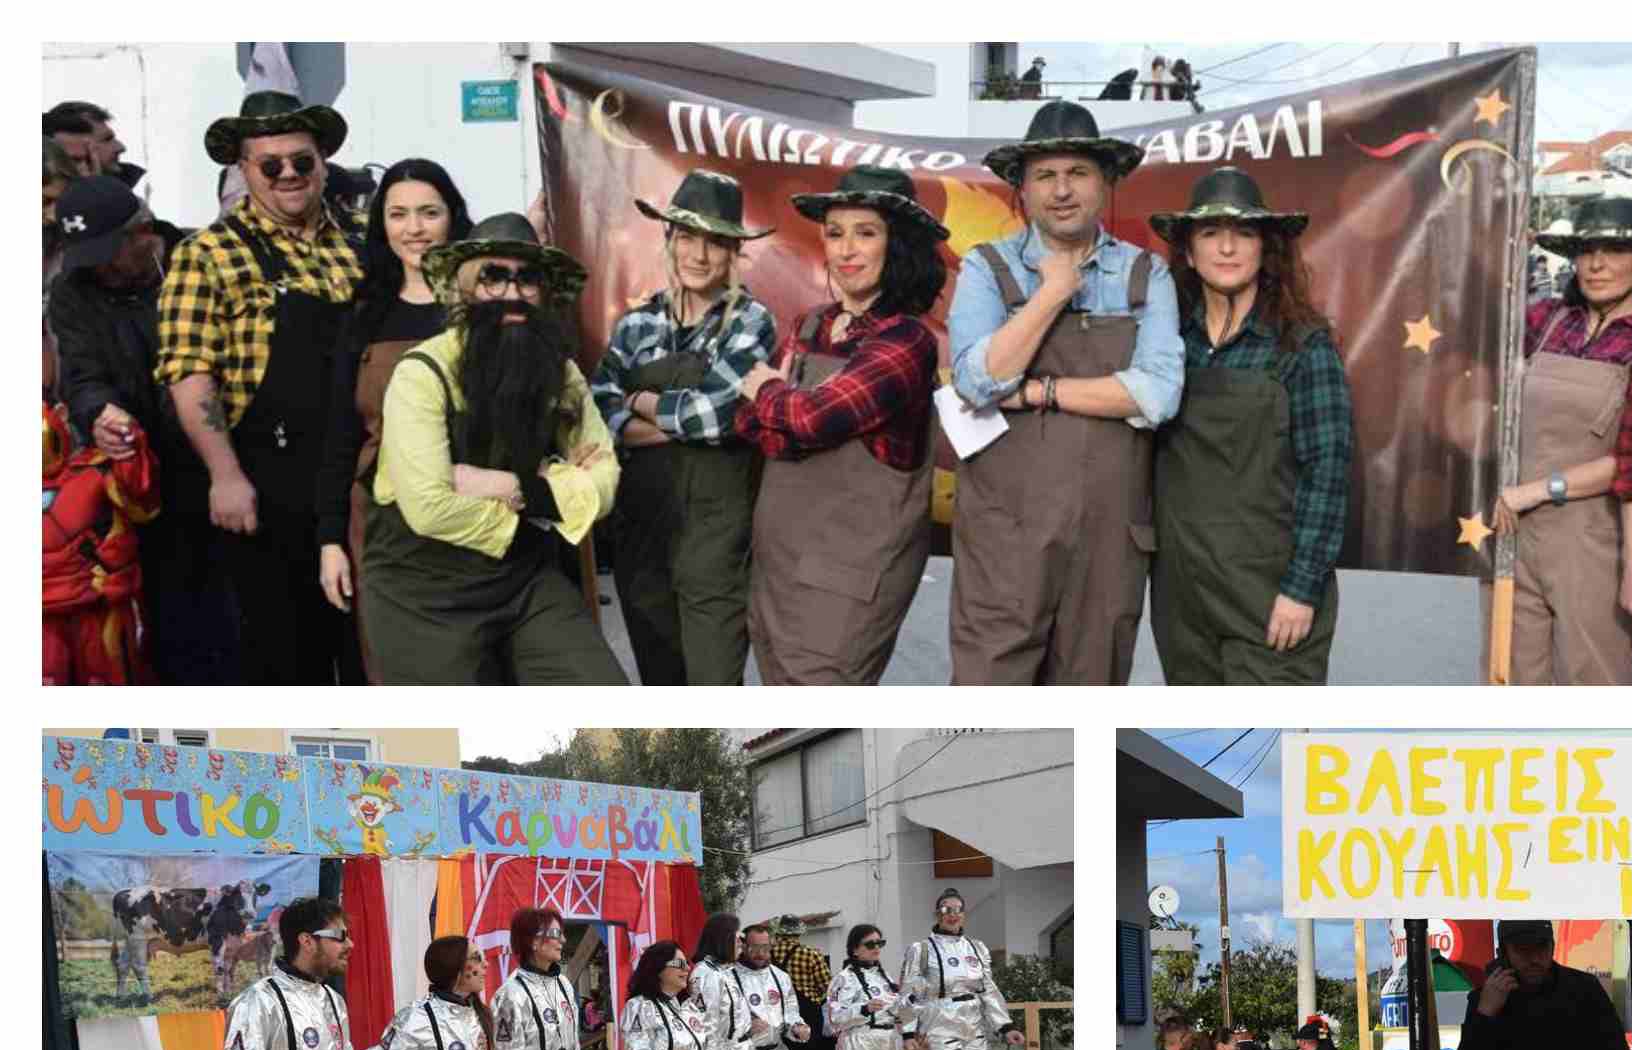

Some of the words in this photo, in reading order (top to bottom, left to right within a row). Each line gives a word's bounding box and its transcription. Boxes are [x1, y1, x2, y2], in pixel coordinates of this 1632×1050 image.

[42, 766, 281, 839] ώτικο
[458, 791, 690, 858] Καρναβάλι
[1304, 743, 1617, 816] ΒΛΕΠΕΙΣ
[1297, 822, 1531, 902] ΚΟΥΛΗΣ
